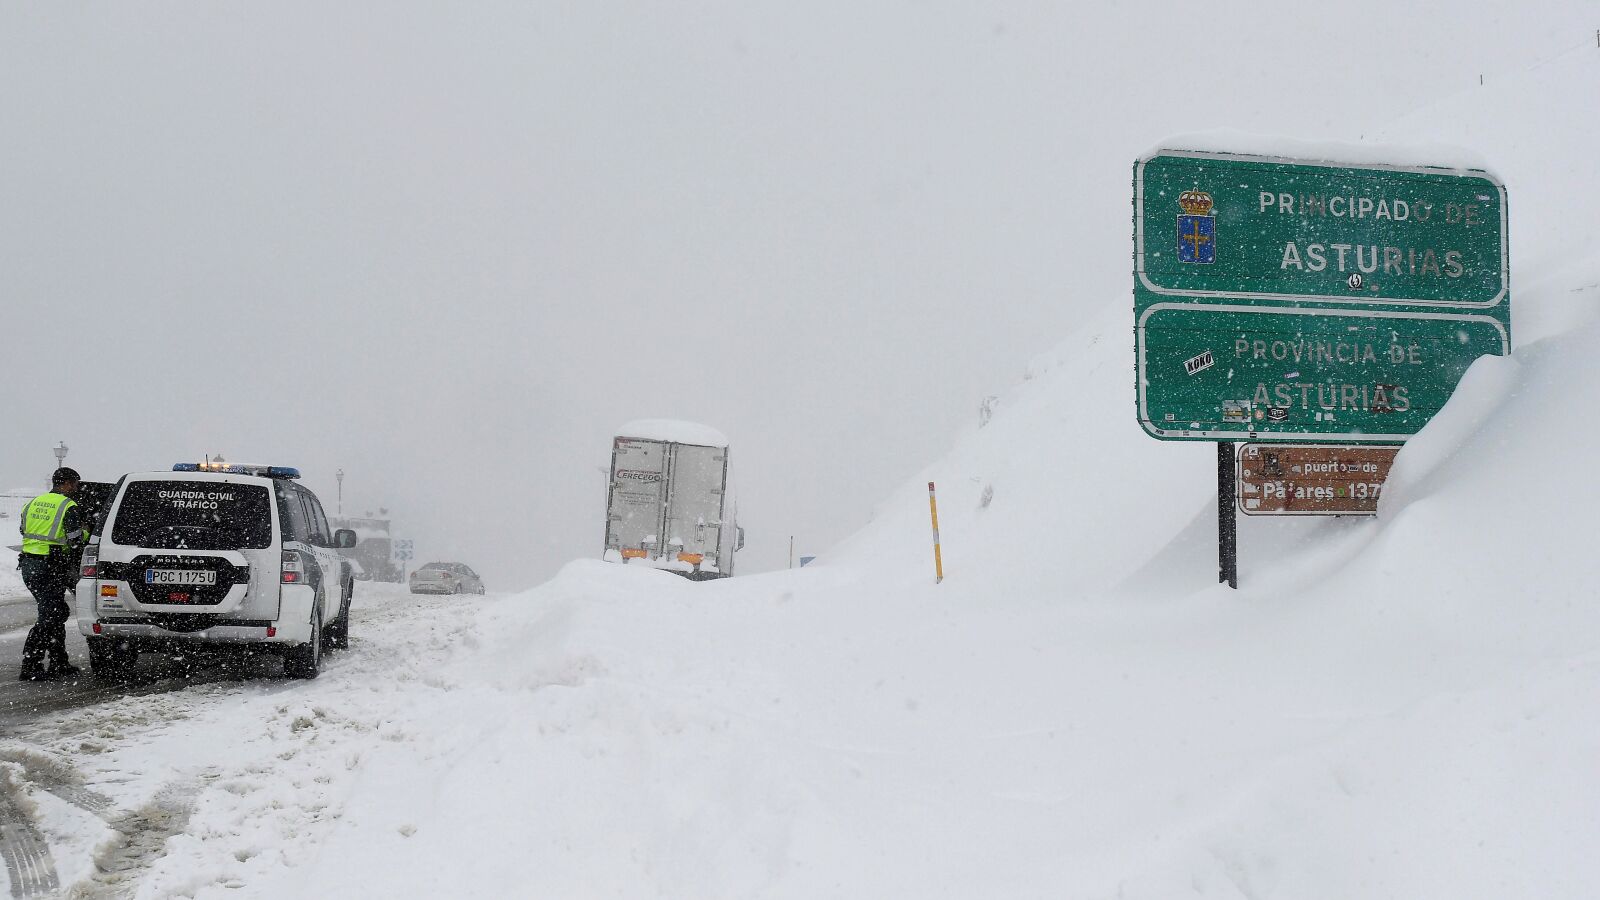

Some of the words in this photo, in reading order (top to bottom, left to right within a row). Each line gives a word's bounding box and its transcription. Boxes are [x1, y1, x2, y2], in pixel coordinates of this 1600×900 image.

[1258, 191, 1432, 222] PRINCIPADO
[1445, 203, 1481, 225] DE
[1280, 241, 1465, 278] ASTURIAS
[1186, 353, 1212, 372] KOKO
[1235, 338, 1377, 364] PROVINCIA
[1390, 343, 1422, 365] DE
[1251, 382, 1410, 412] ASTURIAS
[1362, 461, 1378, 473] de
[158, 490, 205, 500] GUARDIA
[207, 492, 235, 501] CIVIL
[1263, 482, 1334, 500] Paares
